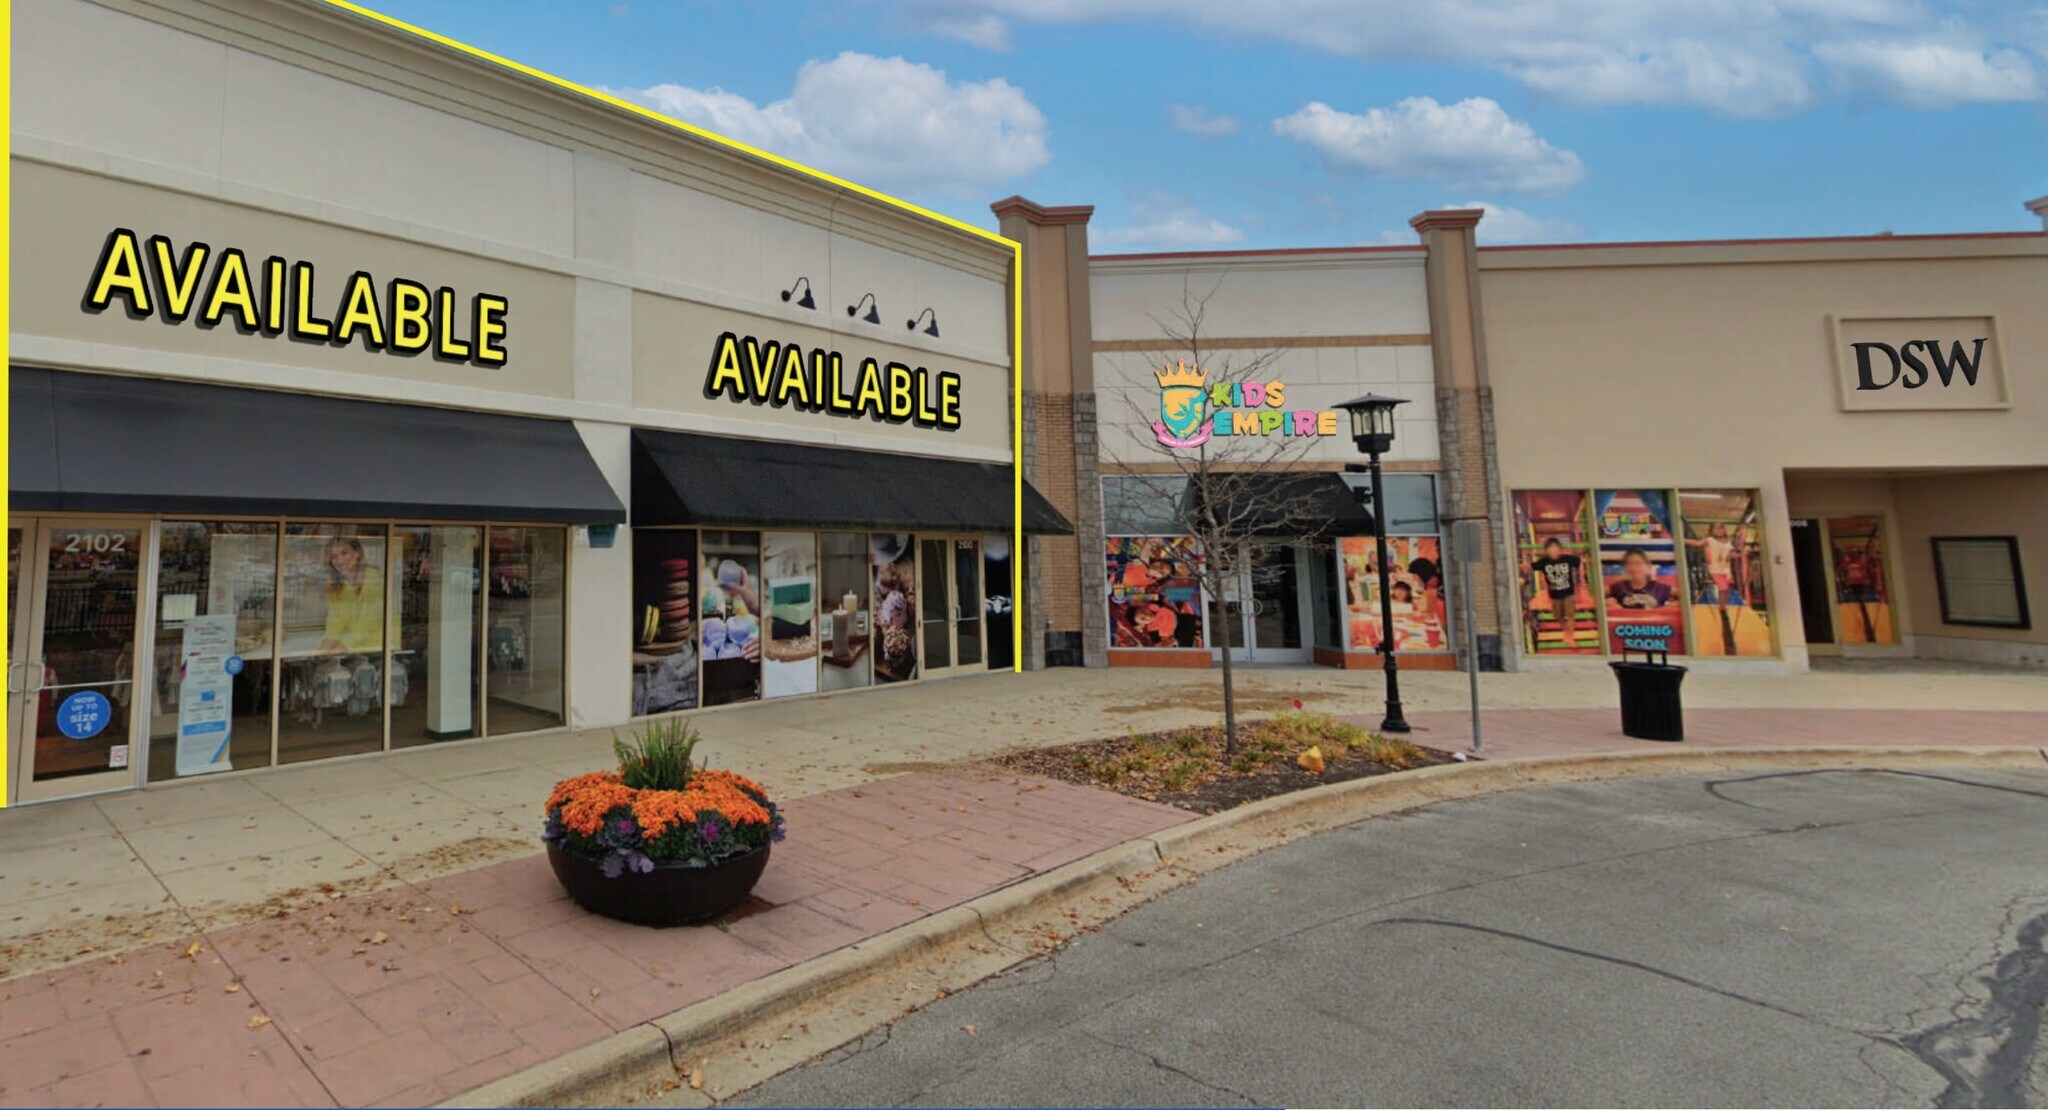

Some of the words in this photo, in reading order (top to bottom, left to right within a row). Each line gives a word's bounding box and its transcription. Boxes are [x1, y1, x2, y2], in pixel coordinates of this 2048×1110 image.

[1850, 338, 1989, 390] DSW
[1212, 380, 1286, 408] KIDS
[1212, 410, 1337, 437] EMPIRE
[65, 533, 126, 553] 2102
[958, 540, 974, 549] 2100
[1614, 624, 1674, 637] COMING
[1624, 638, 1668, 651] SOON
[73, 696, 97, 704] NOW
[69, 711, 98, 724] size
[75, 722, 92, 733] 14
